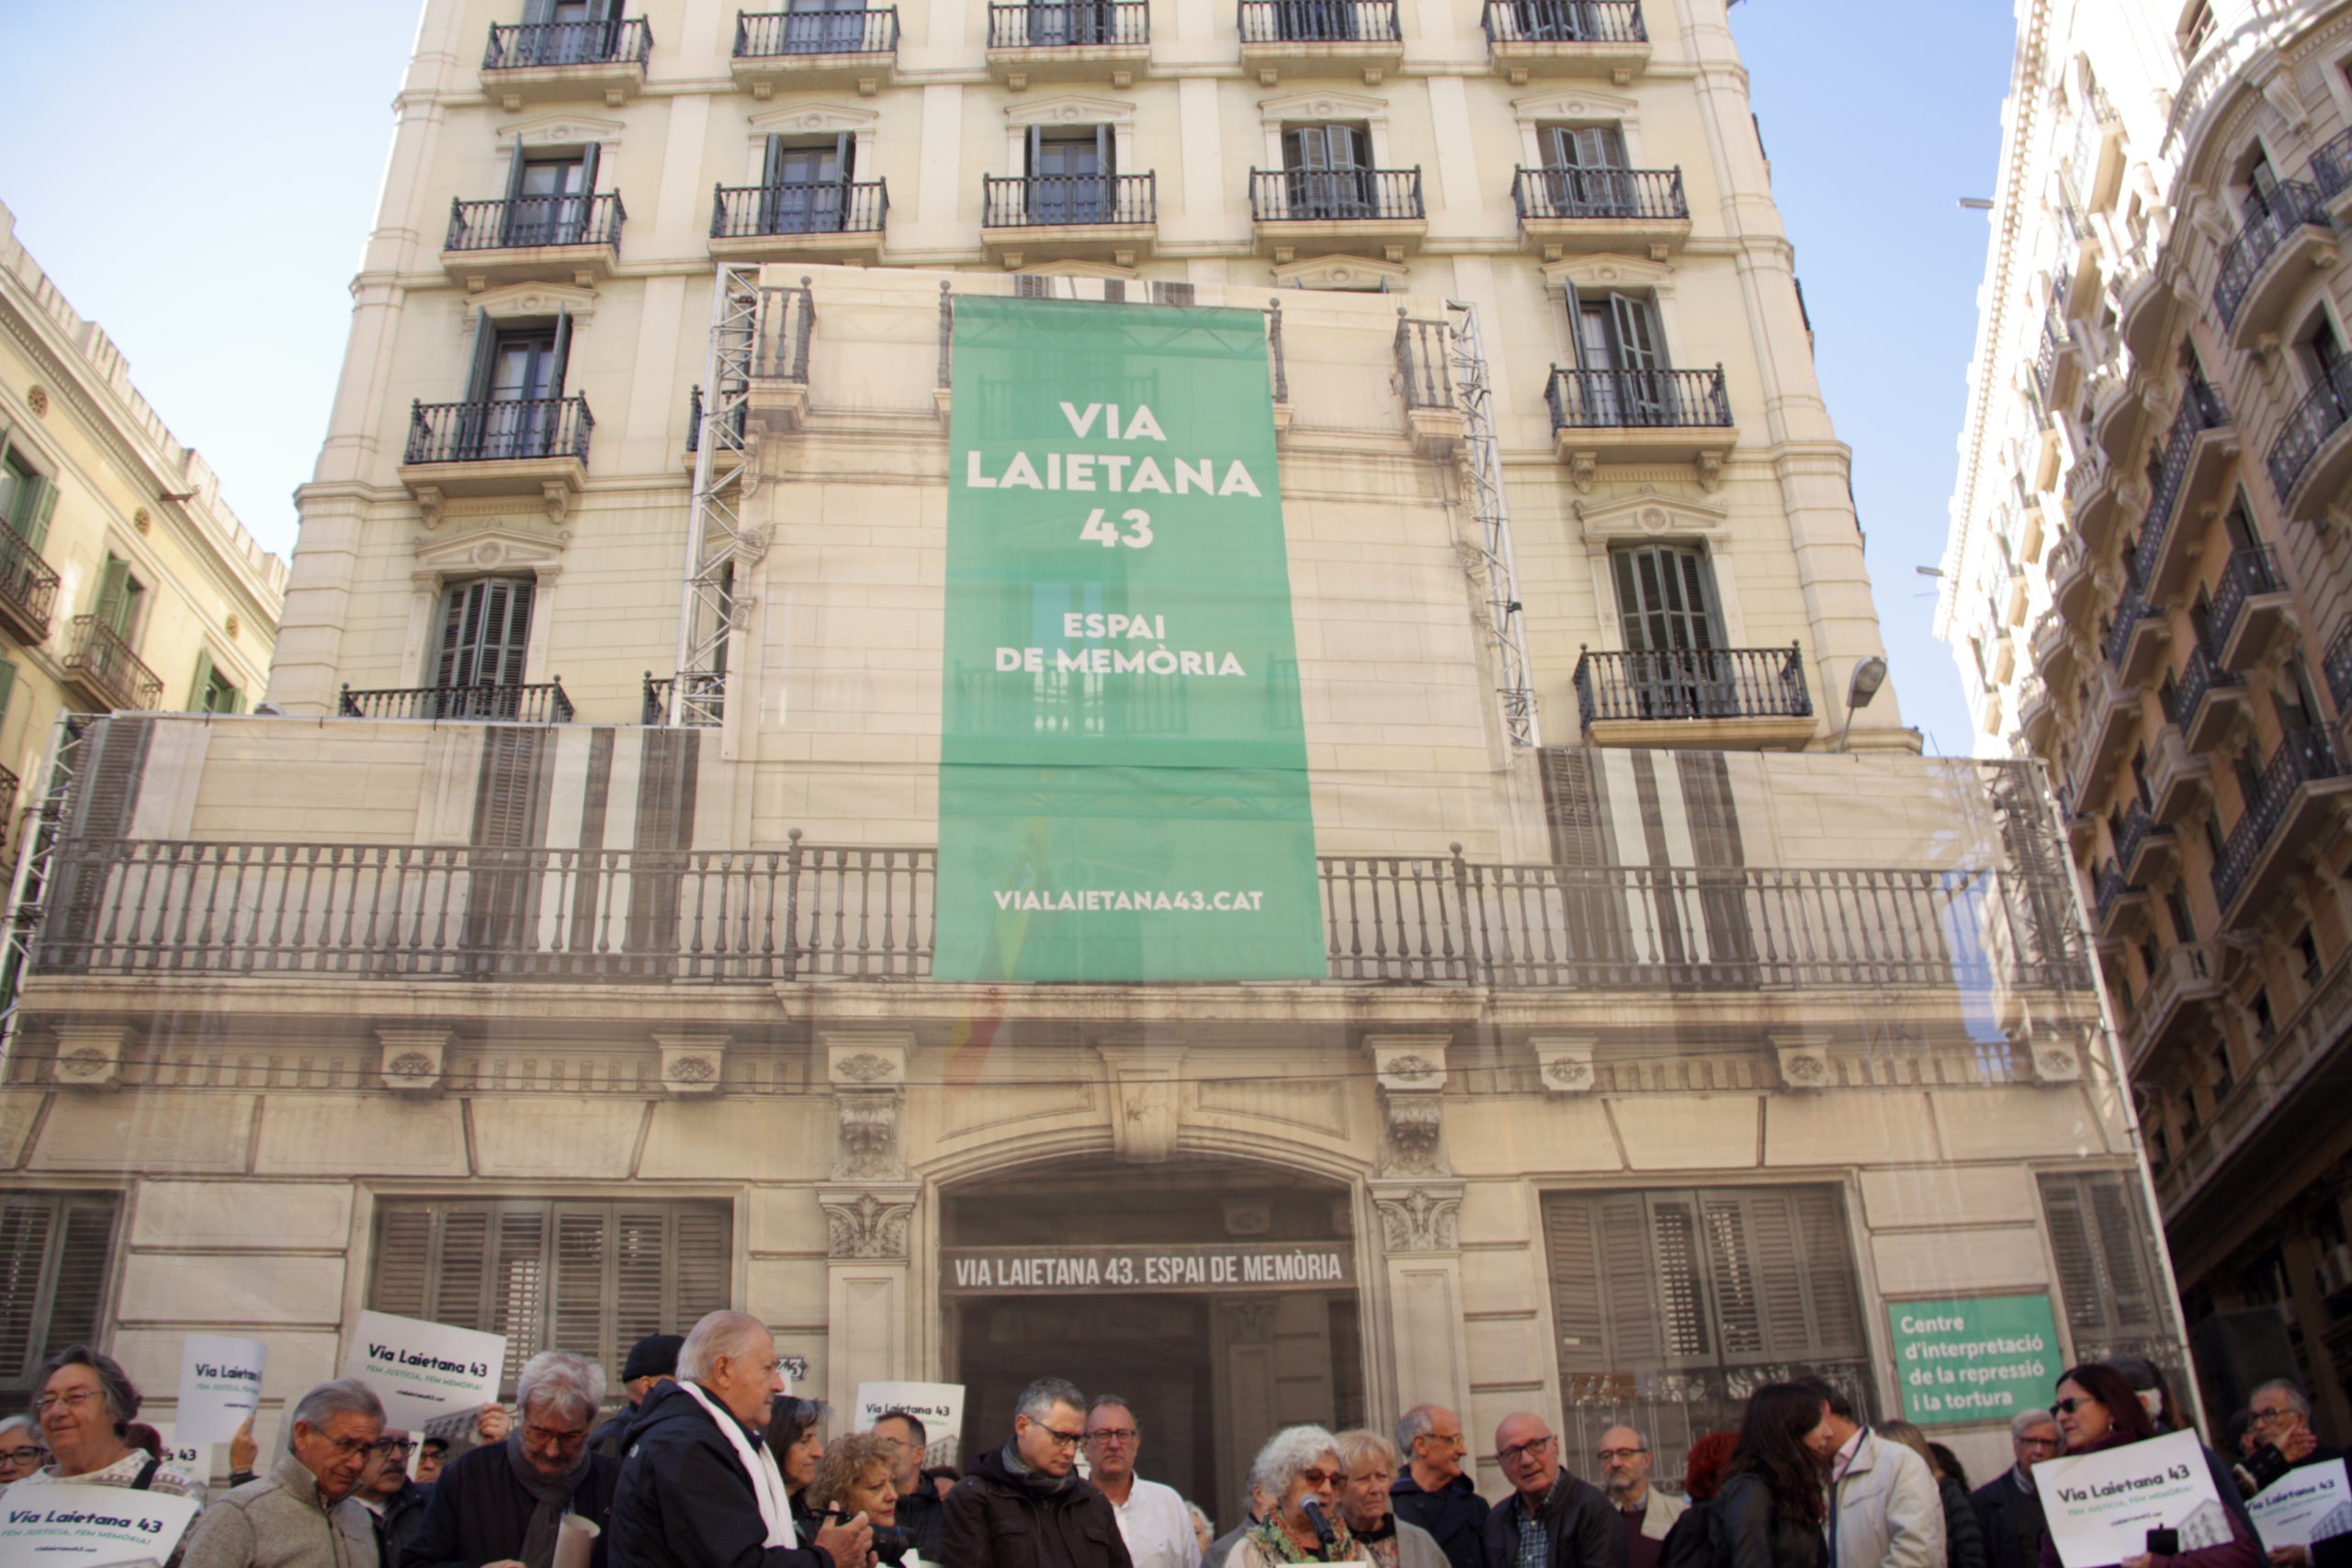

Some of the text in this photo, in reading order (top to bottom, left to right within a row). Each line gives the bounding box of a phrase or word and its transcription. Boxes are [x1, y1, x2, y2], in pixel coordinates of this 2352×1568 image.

[1059, 401, 1167, 441] VIA
[967, 450, 1261, 498] LAIETANA
[1079, 508, 1154, 549] 43
[1063, 613, 1165, 640] ESPAI
[995, 641, 1246, 677] DE MEMÒRIA
[993, 890, 1263, 912] VIALAIETANA43.CAT
[955, 1250, 1342, 1286] VIA LAIETANA 43. ESPAI DE MEMÒRIA
[1900, 1315, 1965, 1335] Centre
[1905, 1333, 2044, 1360] d'interpretació
[195, 1363, 218, 1378] Via
[368, 1343, 488, 1378] Via Laietana 43
[775, 1358, 802, 1378] 43
[1909, 1359, 2045, 1386] de la repressió
[865, 1403, 951, 1416] Via Laietana 43
[1912, 1390, 2014, 1412] i la tortura
[178, 1448, 197, 1461] 43
[2057, 1464, 2190, 1503] Via Laietana 43
[1, 1529, 22, 1537] FEM
[74, 1528, 96, 1538] FEM
[7, 1509, 164, 1533] Via Laietana 43
